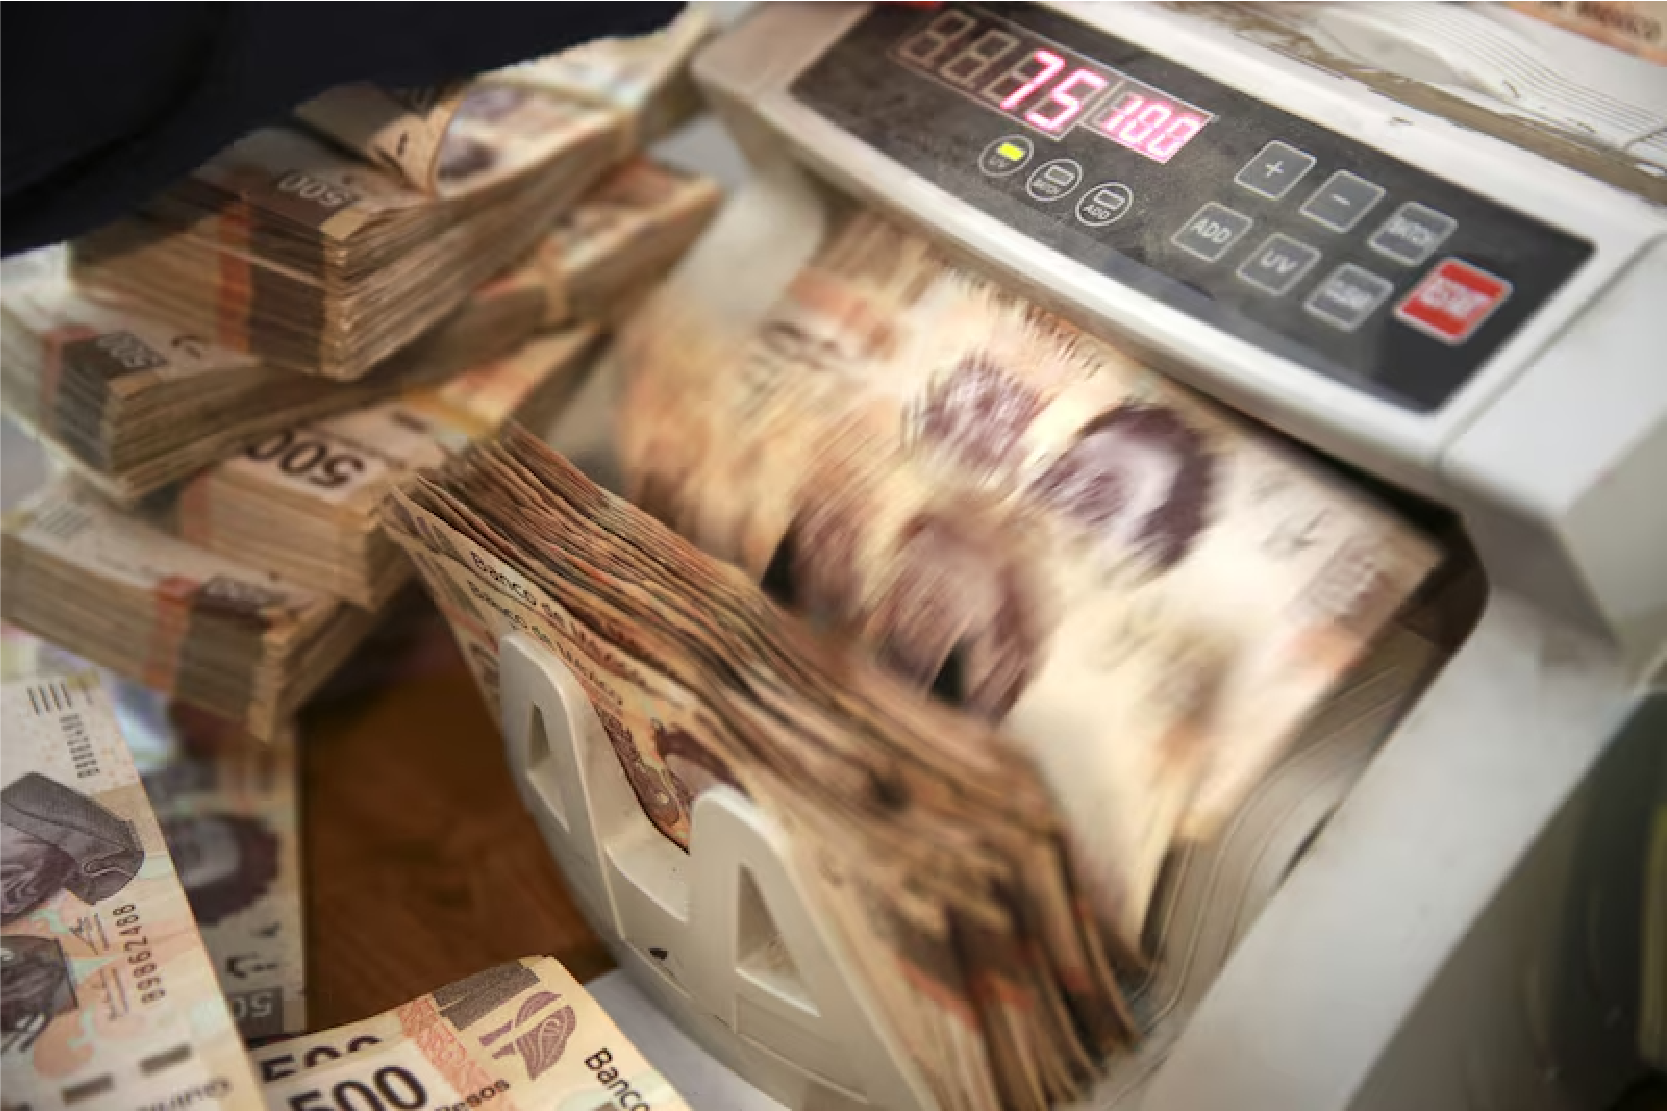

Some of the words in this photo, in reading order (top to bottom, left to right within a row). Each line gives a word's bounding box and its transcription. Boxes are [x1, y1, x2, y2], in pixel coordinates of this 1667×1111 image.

[1000, 48, 1108, 132] 75
[1104, 94, 1203, 157] 100
[1189, 218, 1233, 243] ADD
[1260, 249, 1298, 274] UV
[246, 428, 365, 490] 500
[433, 1078, 511, 1111] esos
